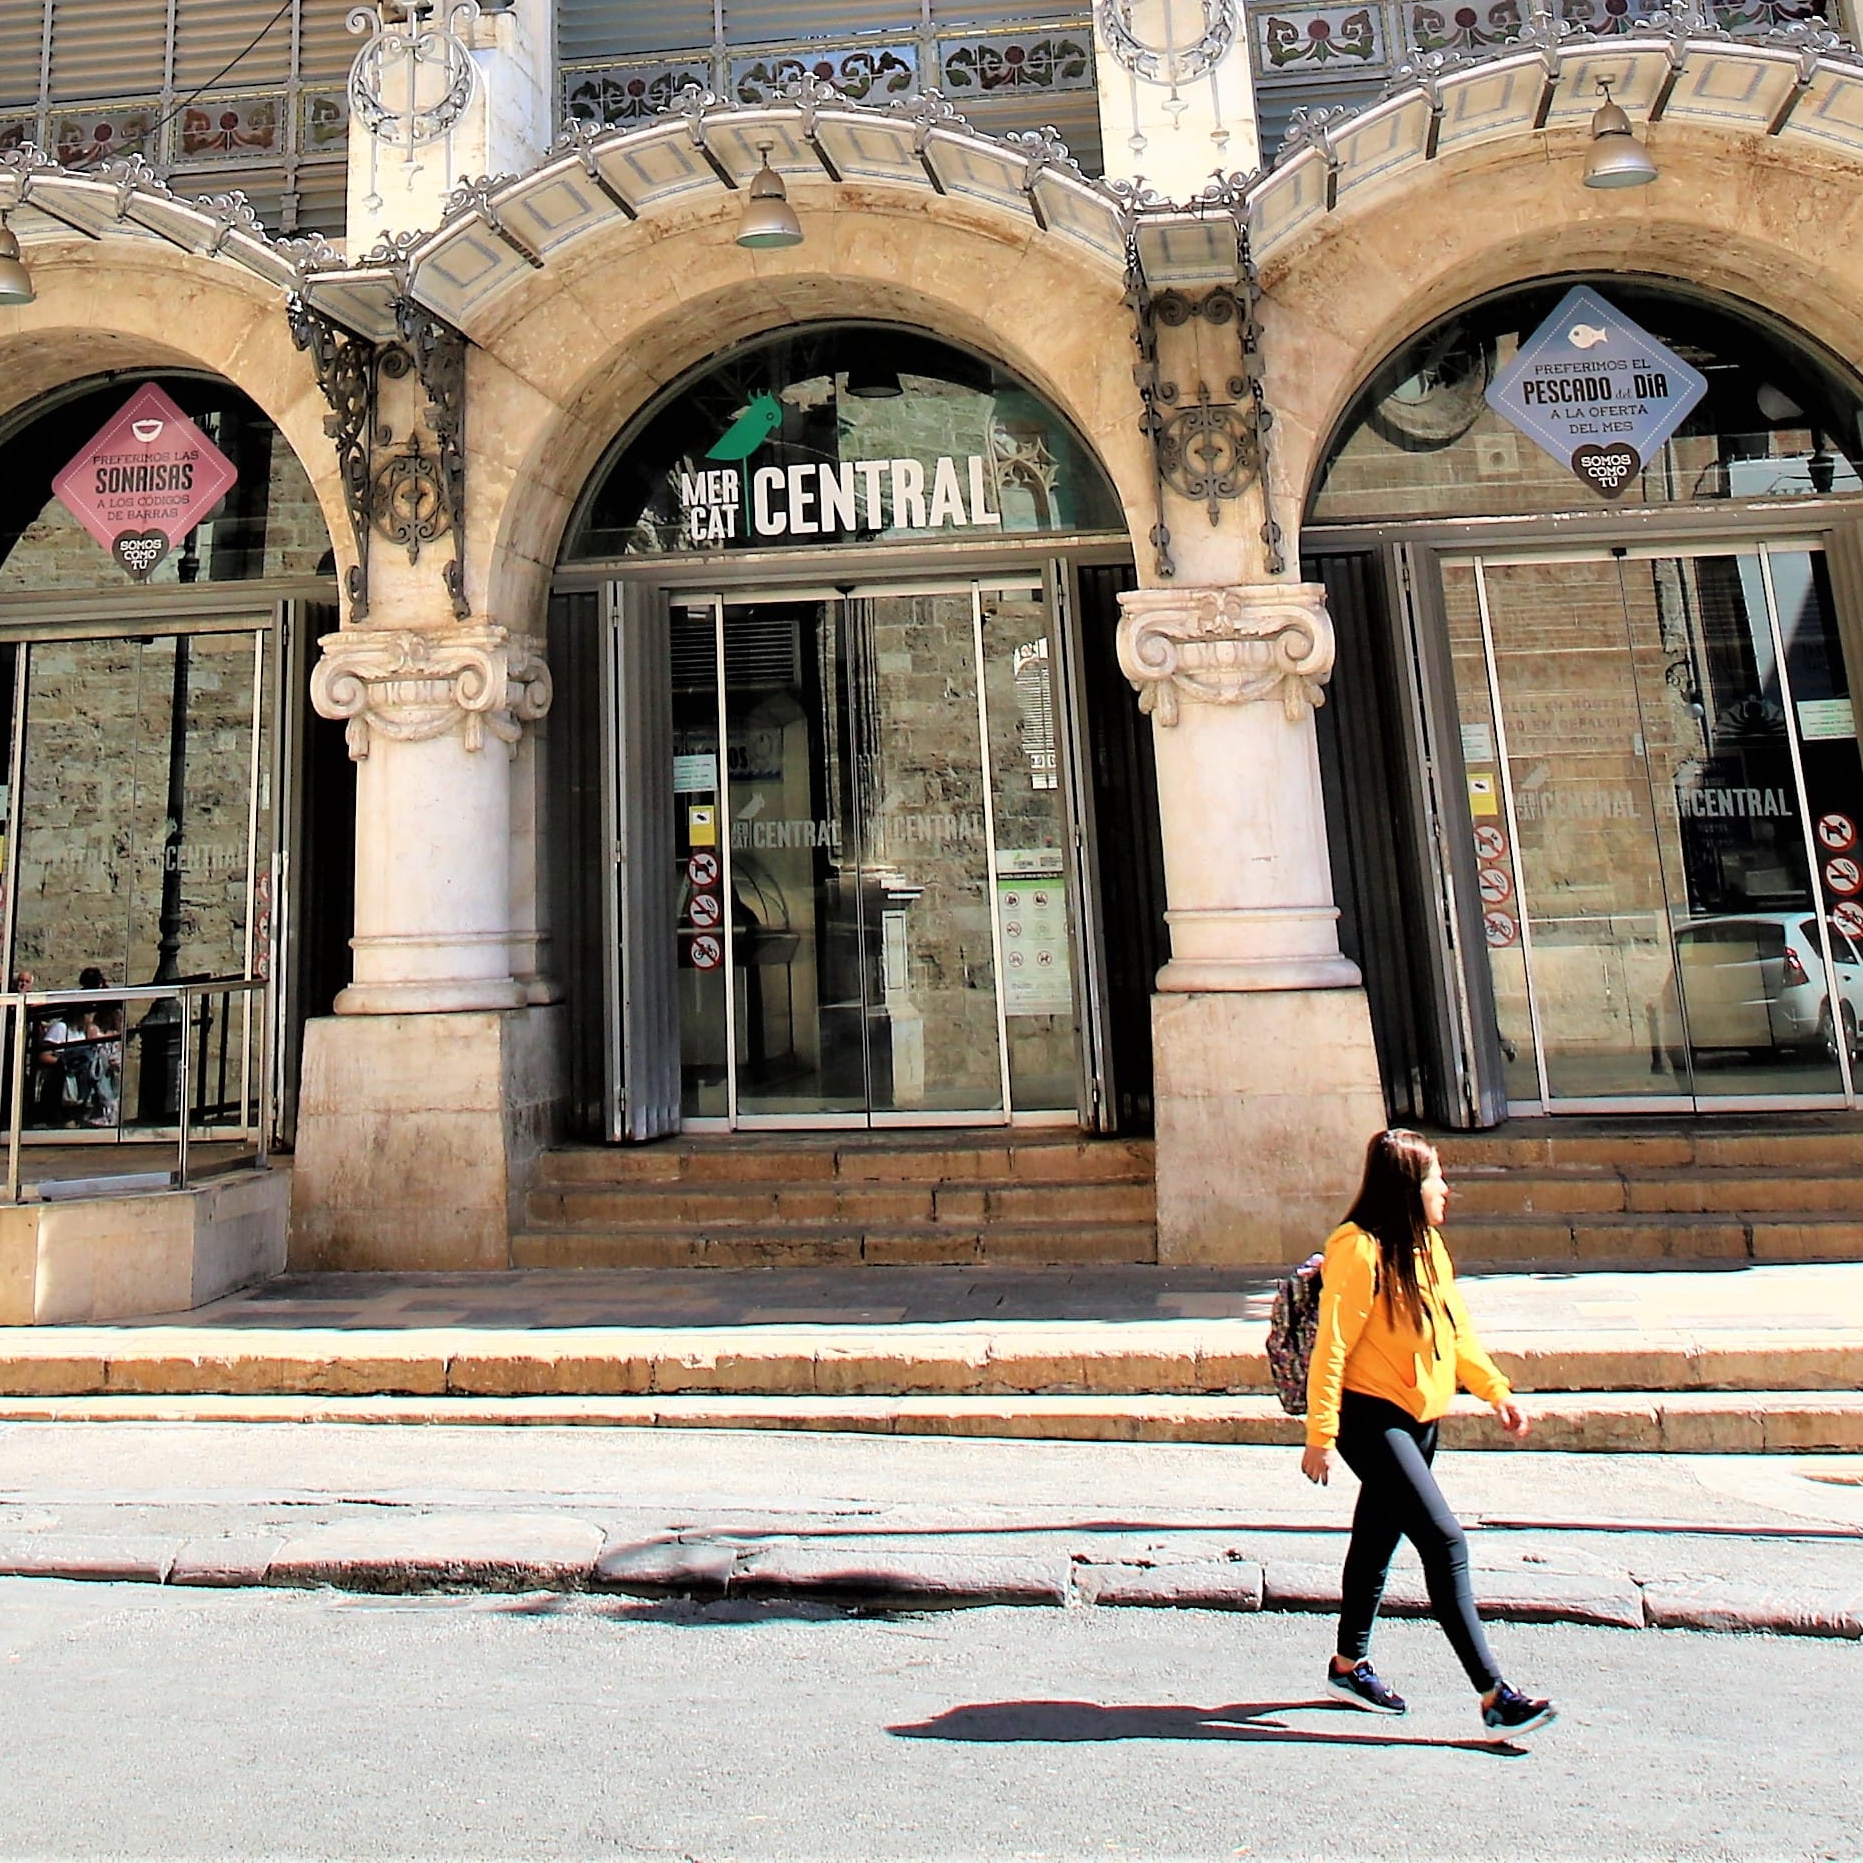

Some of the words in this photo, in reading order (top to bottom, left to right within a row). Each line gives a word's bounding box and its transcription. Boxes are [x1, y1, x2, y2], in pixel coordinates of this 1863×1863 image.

[1534, 359, 1629, 376] PREFERIMOS
[1631, 359, 1652, 370] EL
[1522, 376, 1613, 406] PESCADO
[1614, 388, 1633, 401] del
[1550, 409, 1561, 420] A
[1565, 407, 1586, 419] LA
[1589, 404, 1649, 417] OFERTA
[1569, 423, 1599, 435] DEL
[1603, 421, 1634, 433] MES
[93, 453, 171, 466] PREFERIMOS
[174, 450, 200, 461] LAS
[1580, 453, 1632, 468] SOMOS
[95, 463, 194, 495] SONRISAS
[1587, 465, 1628, 478] COMO
[97, 498, 106, 510] A
[109, 496, 135, 509] LOS
[681, 468, 739, 507] MER
[753, 455, 1002, 537] CENTRAL
[107, 510, 124, 522] DE
[127, 507, 179, 521] BARRAS
[690, 502, 739, 542] CAT
[120, 538, 162, 552] SOMOS
[123, 549, 157, 562] COMO
[1693, 788, 1793, 817] CENTRAL
[752, 819, 842, 849] CENTRAL
